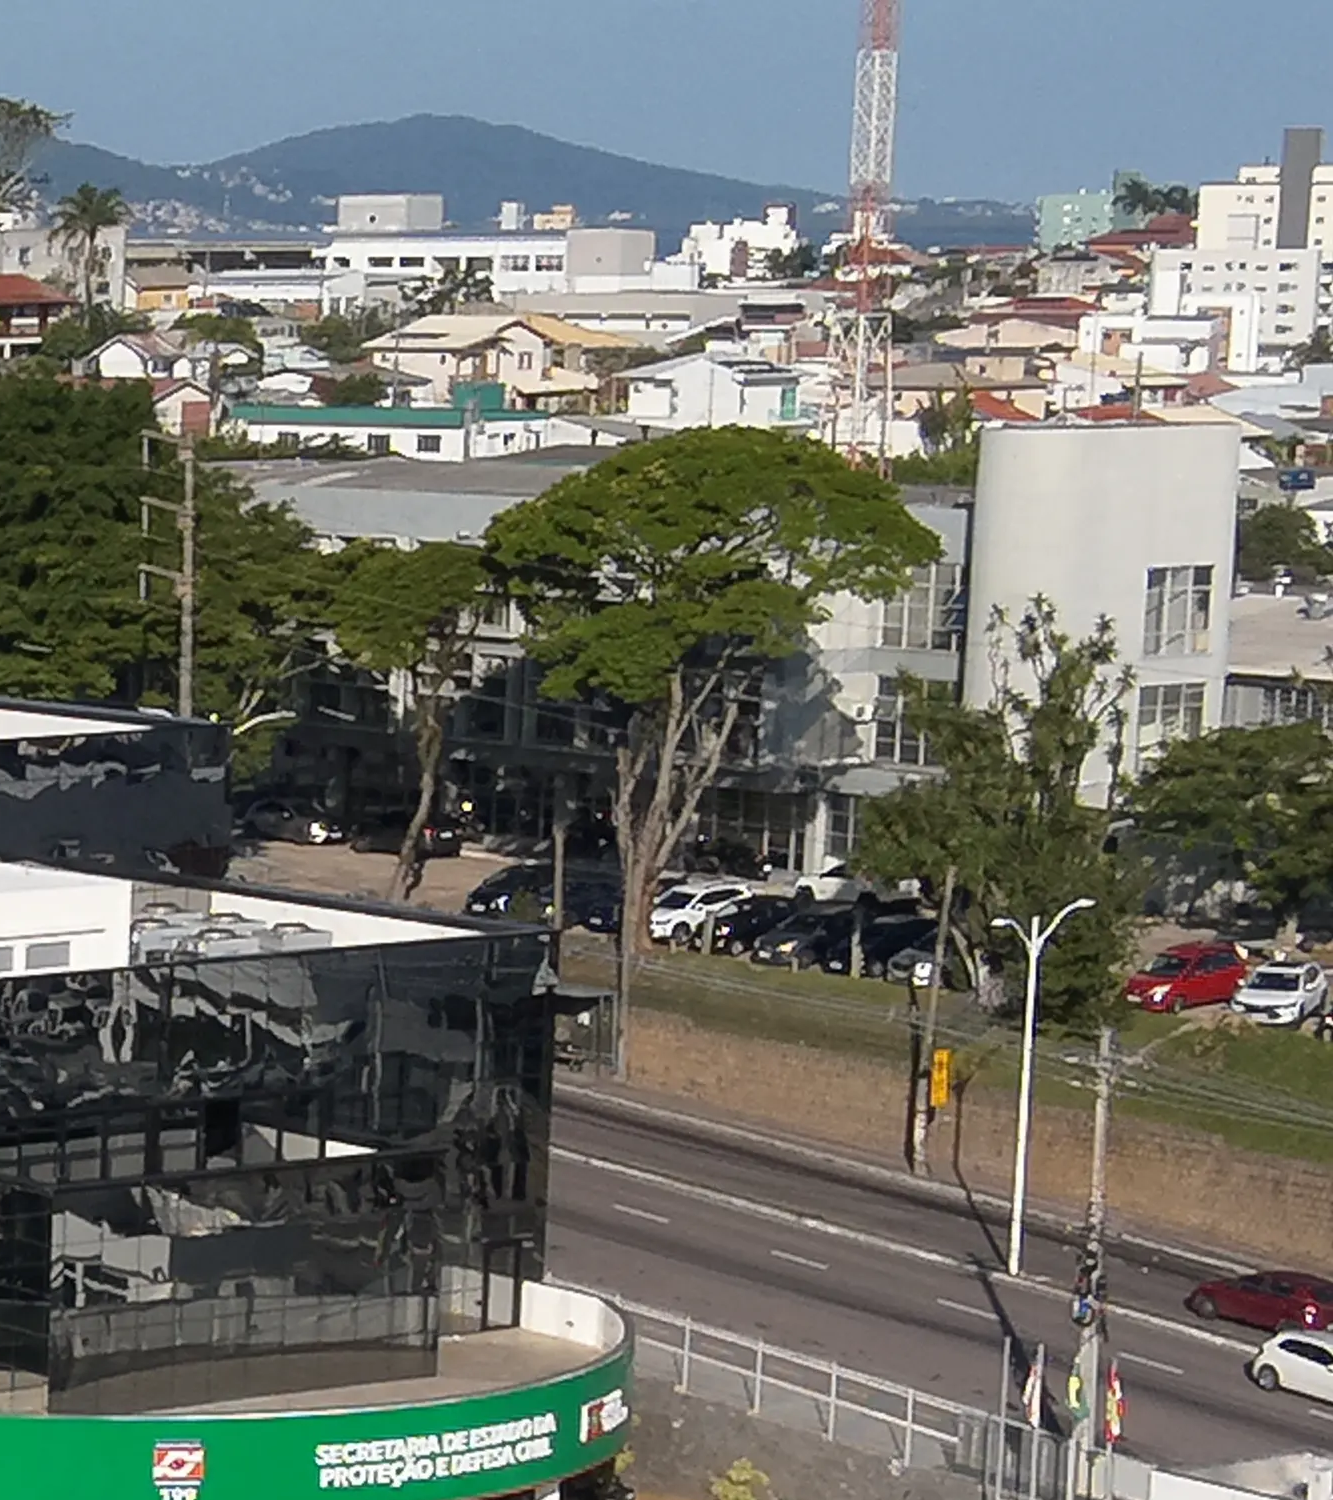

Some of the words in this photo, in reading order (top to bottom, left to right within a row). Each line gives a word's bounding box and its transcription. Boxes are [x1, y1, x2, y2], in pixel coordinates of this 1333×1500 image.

[315, 1435, 440, 1465] SECRETARIA
[442, 1430, 468, 1451] DE
[470, 1418, 533, 1447] ESTADO
[319, 1456, 433, 1488] PROTEÇÃO
[436, 1456, 450, 1476] E
[451, 1446, 515, 1475] DEFESA
